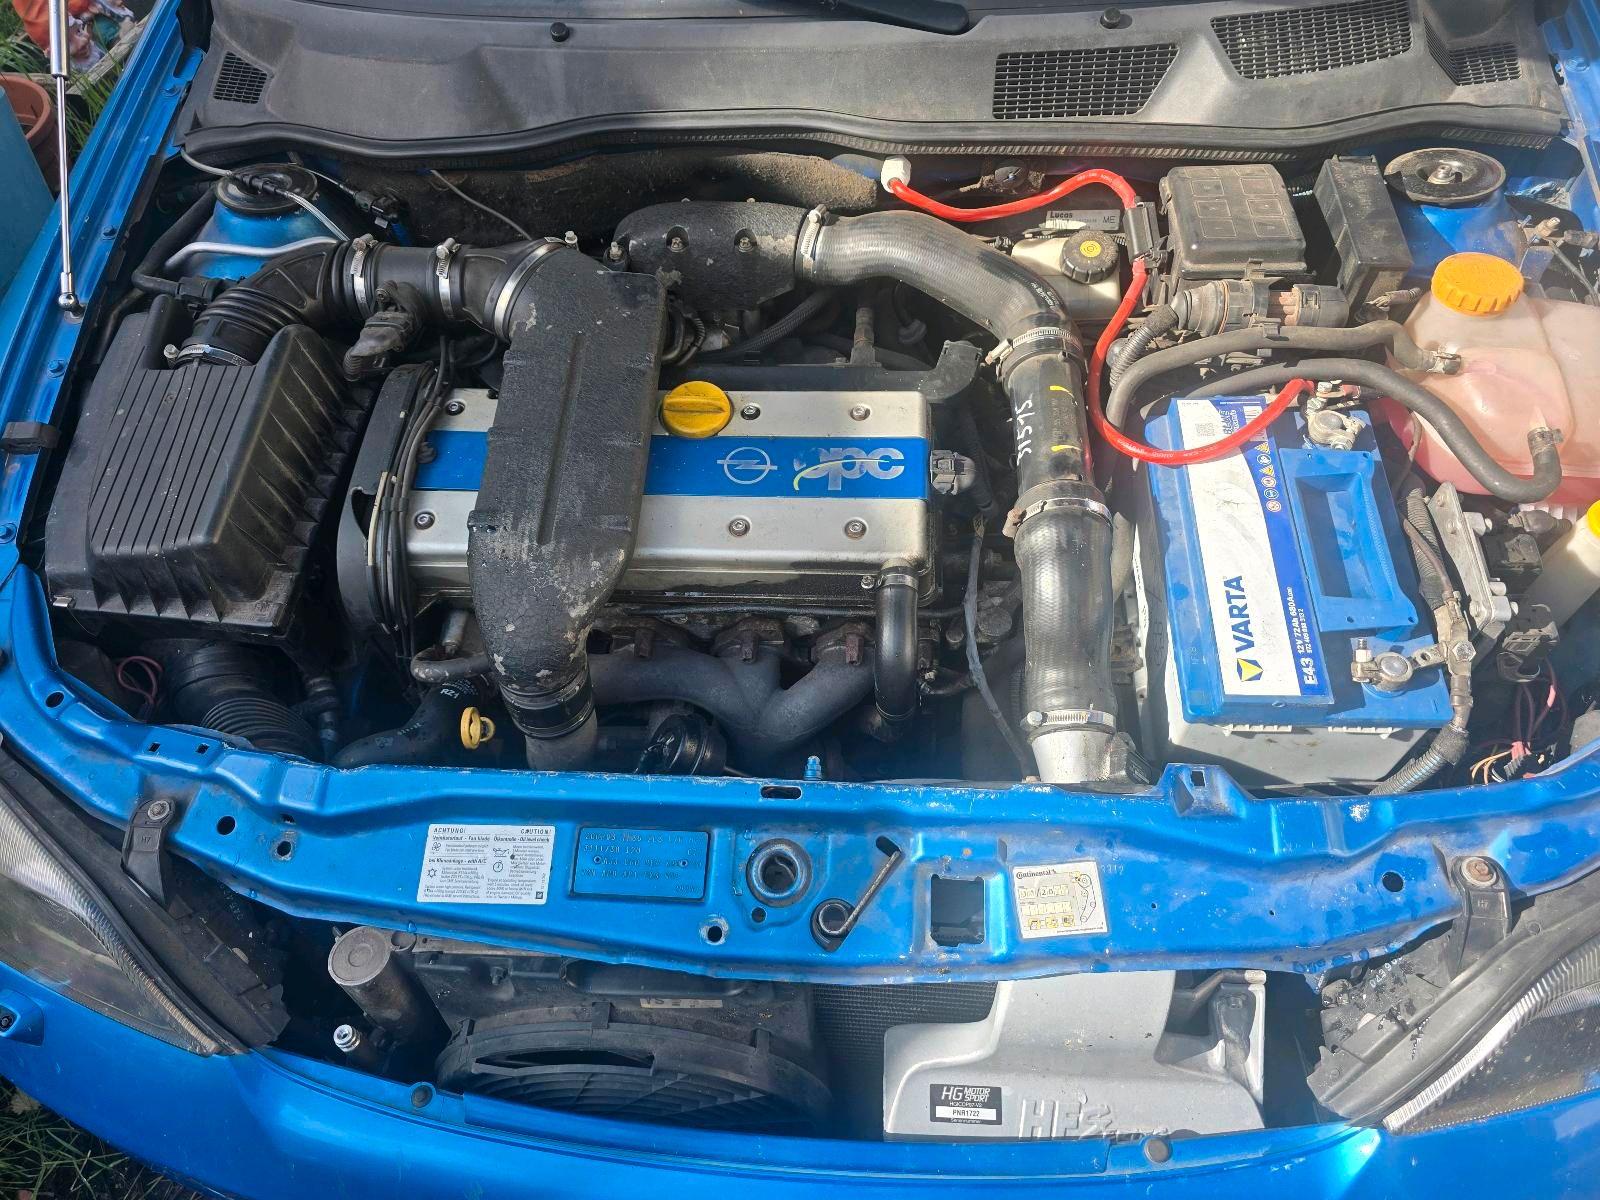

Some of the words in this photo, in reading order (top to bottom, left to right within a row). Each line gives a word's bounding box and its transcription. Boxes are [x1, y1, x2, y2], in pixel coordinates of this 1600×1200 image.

[1050, 211, 1073, 219] Lucas
[1103, 215, 1116, 224] ME
[1223, 575, 1255, 653] VARTA
[1300, 657, 1319, 685] E43
[1016, 869, 1051, 880] Continental
[940, 1086, 963, 1101] HG
[963, 1086, 991, 1096] MOTOR
[964, 1094, 989, 1103] SPORT
